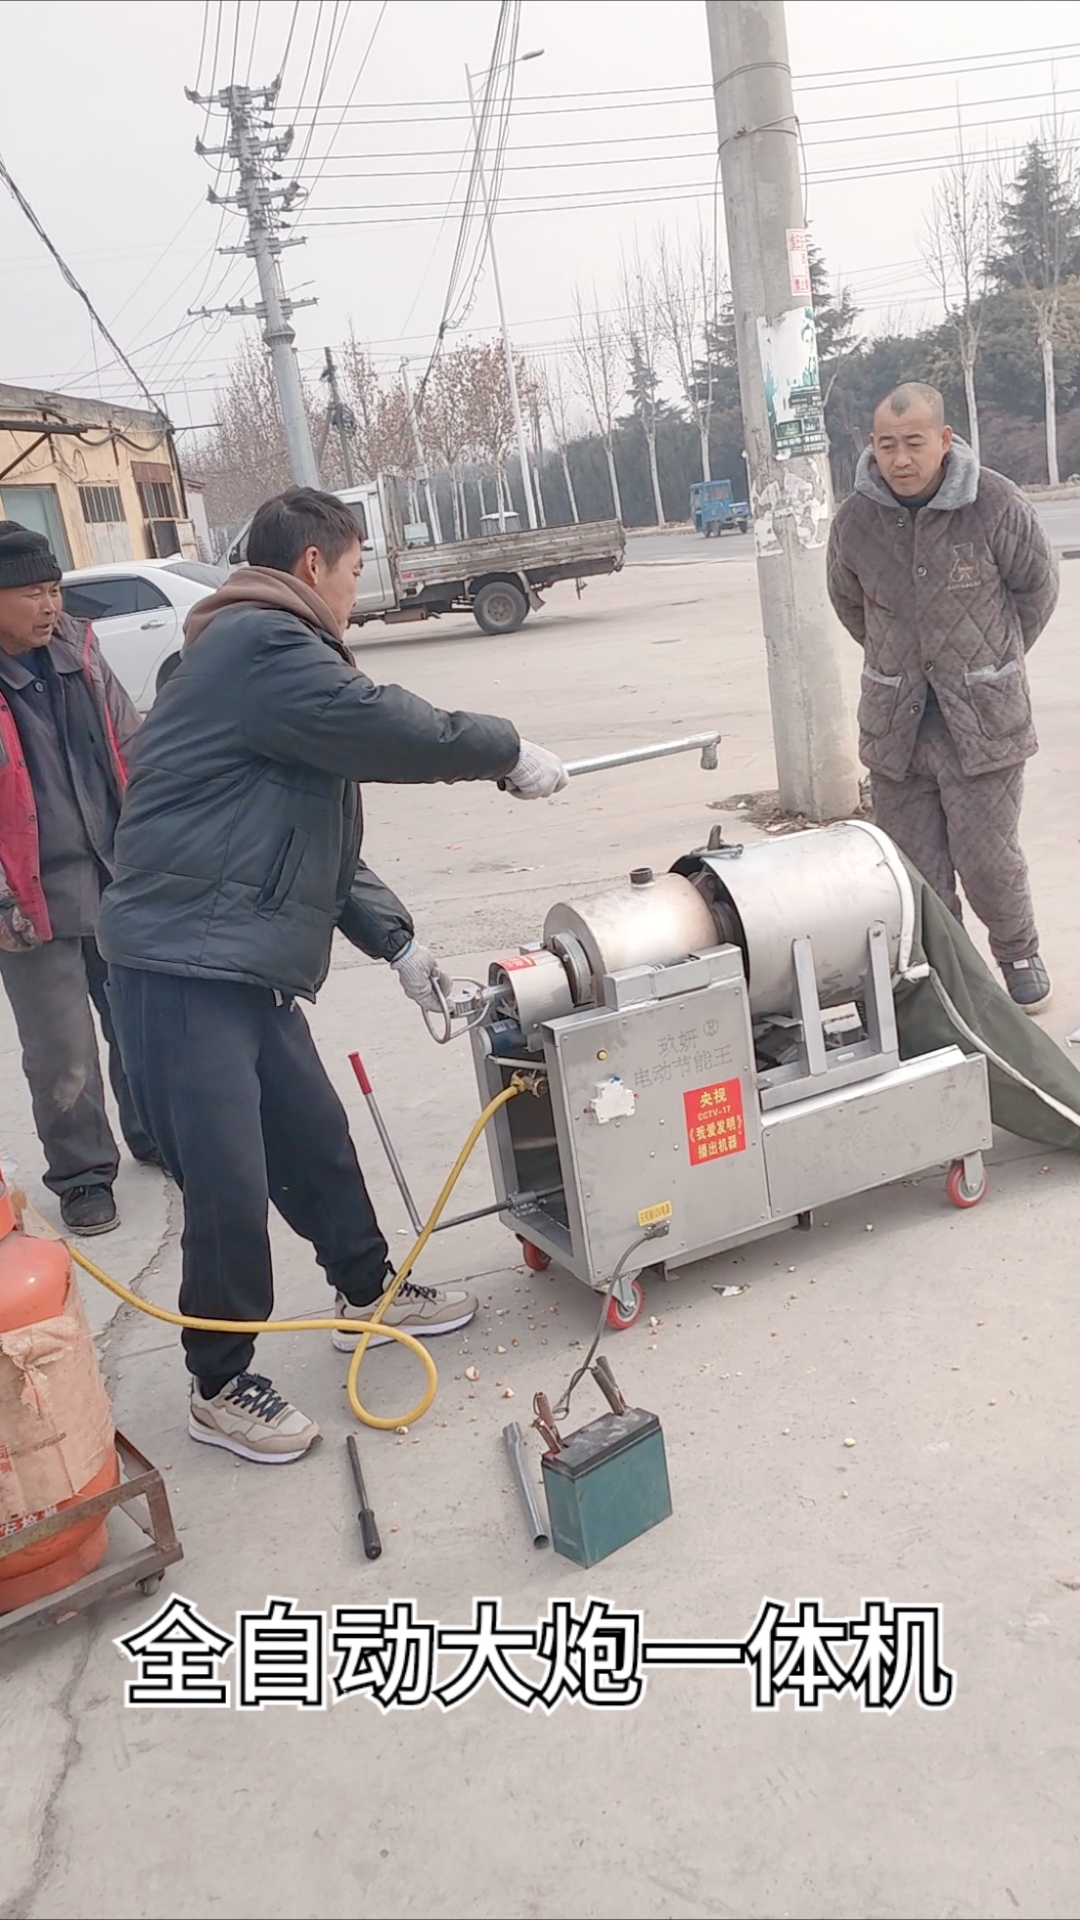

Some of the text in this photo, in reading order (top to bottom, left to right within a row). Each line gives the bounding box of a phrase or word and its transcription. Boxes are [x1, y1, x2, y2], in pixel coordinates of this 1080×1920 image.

[634, 1044, 733, 1088] 电动节能王
[700, 1087, 727, 1108] 央视
[697, 1105, 731, 1121] CCTV-17
[698, 1135, 737, 1159] 播出机器
